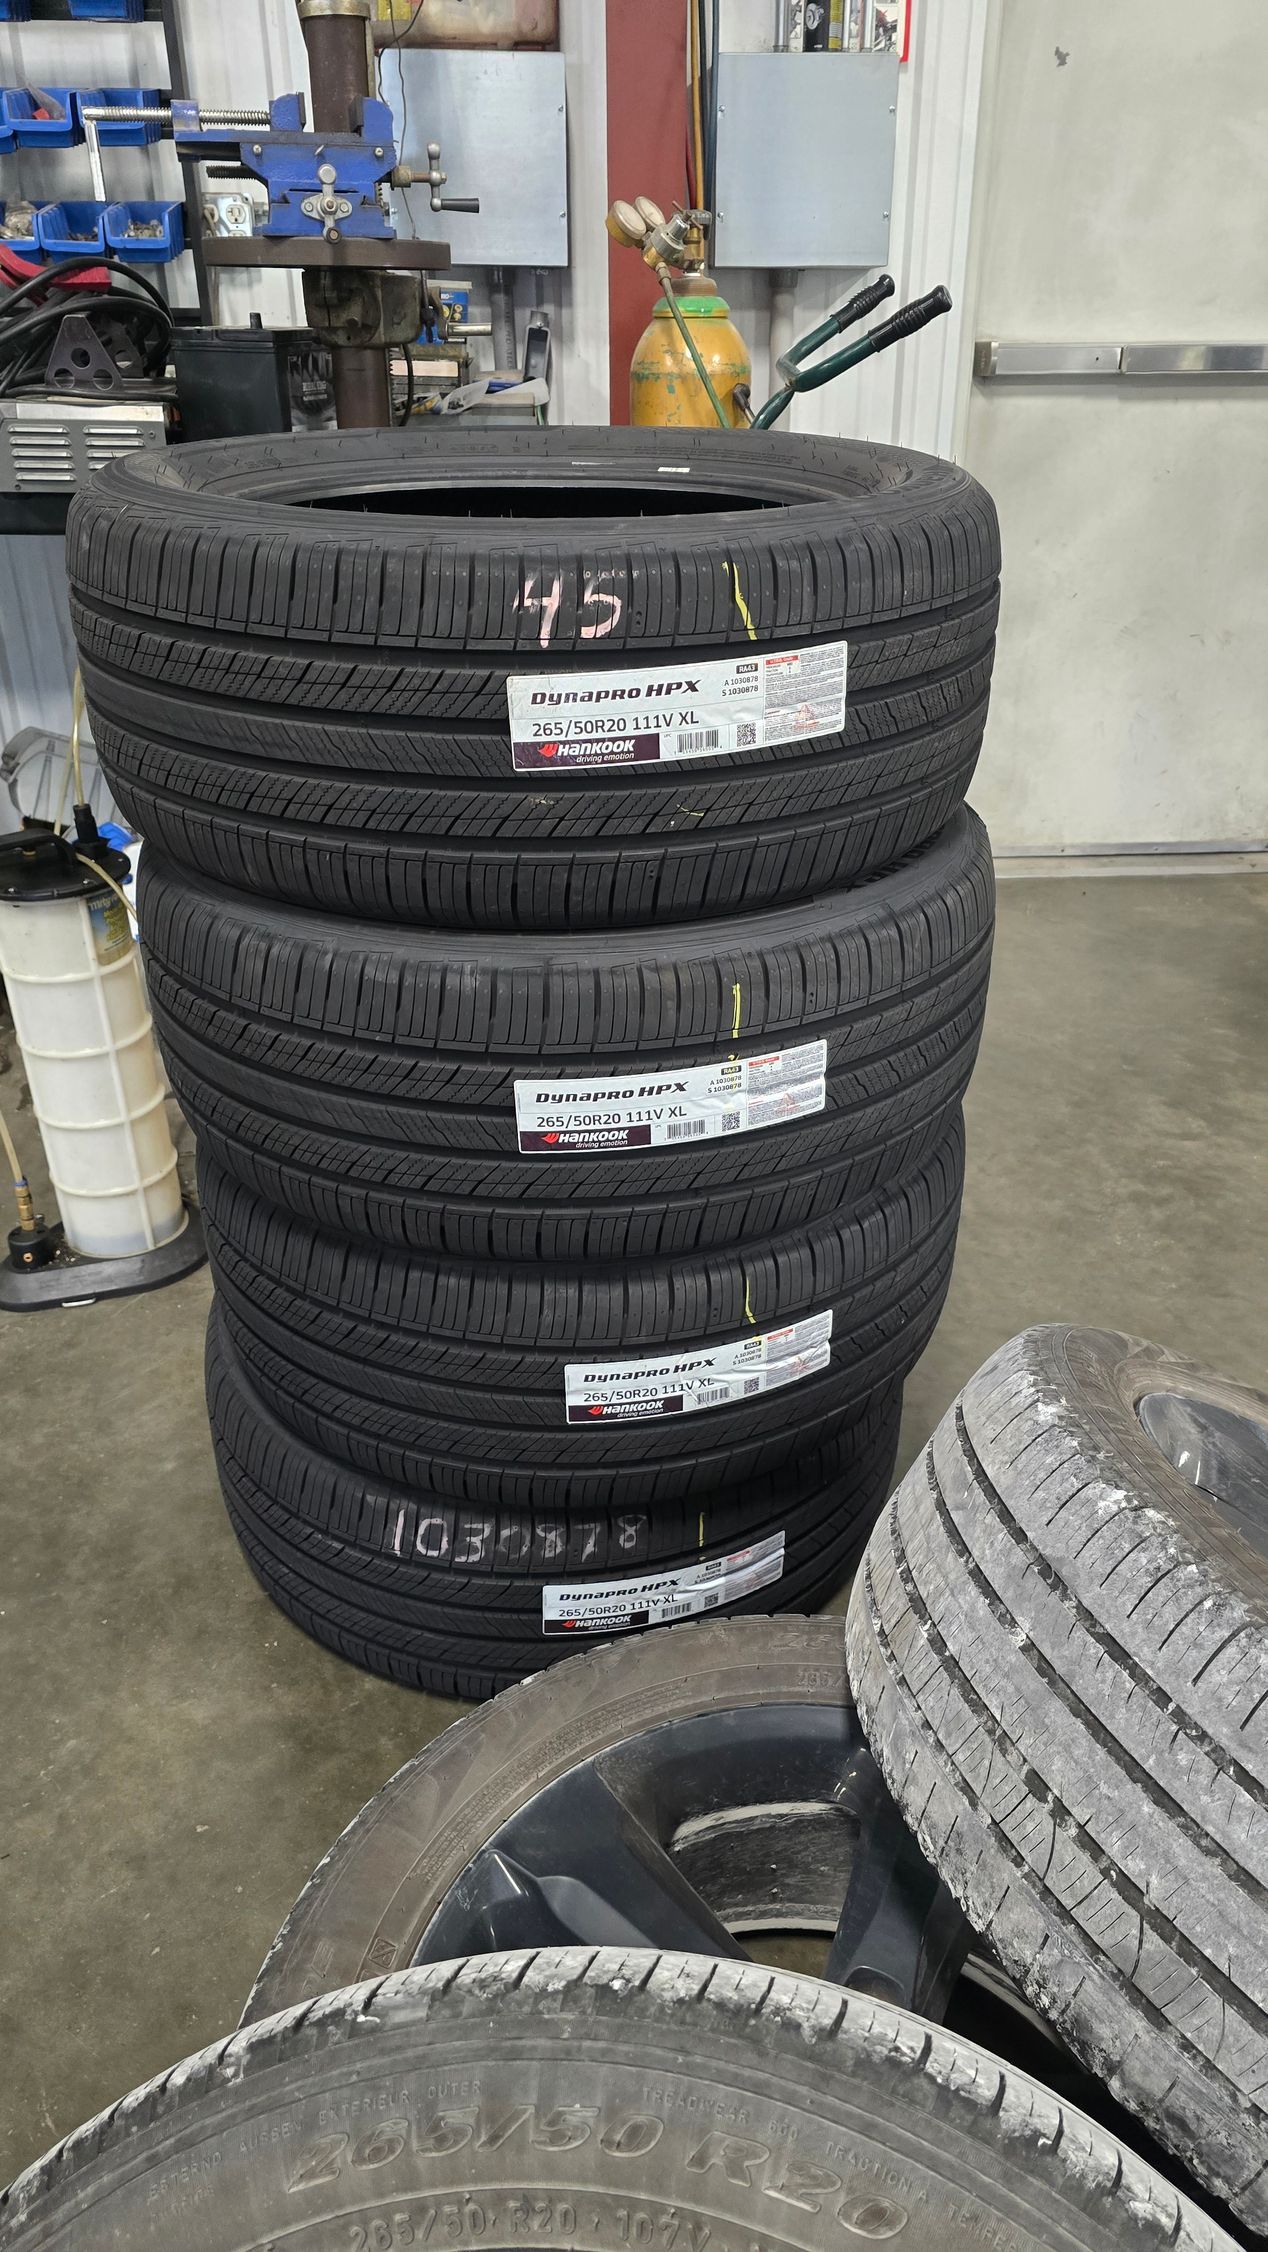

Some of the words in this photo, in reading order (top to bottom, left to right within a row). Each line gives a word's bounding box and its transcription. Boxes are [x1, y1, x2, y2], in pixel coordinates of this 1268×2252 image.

[512, 572, 622, 648] 45
[738, 664, 756, 674] RA43
[645, 679, 701, 698] HPX
[731, 675, 759, 686] 1030878
[722, 689, 727, 697] S
[728, 685, 759, 696] 1030878
[532, 717, 627, 737] 265/50R20
[632, 713, 673, 730] 111V
[678, 711, 699, 726] XL
[576, 753, 602, 764] driving
[603, 751, 635, 762] emotion
[713, 1082, 742, 1093] 1030878
[716, 1075, 742, 1085] 1030878
[638, 1081, 689, 1098] HPX
[536, 1113, 621, 1128] 265/50R20
[626, 1108, 664, 1123] 111V
[668, 1105, 687, 1119] XL
[575, 1140, 599, 1149] driving
[600, 1139, 628, 1147] emotion
[673, 1357, 717, 1374] HPX
[583, 1387, 658, 1402] 265/50R20
[662, 1380, 695, 1395] 111V
[698, 1377, 715, 1389] XL
[617, 1410, 638, 1418] driving
[638, 1408, 664, 1416] emotion
[392, 1508, 648, 1563] 1030878
[641, 1577, 681, 1593] HPX
[559, 1604, 626, 1618] 265/50R20
[630, 1598, 660, 1611] 111V
[663, 1593, 679, 1605] XL
[427, 2079, 482, 2099] OUTER
[288, 2104, 664, 2193] 265/50
[686, 2130, 908, 2240] R20
[825, 2140, 912, 2192] TRACTION
[350, 2203, 487, 2252] 265/50
[508, 2200, 577, 2236] R20
[616, 2207, 712, 2252] 107V
